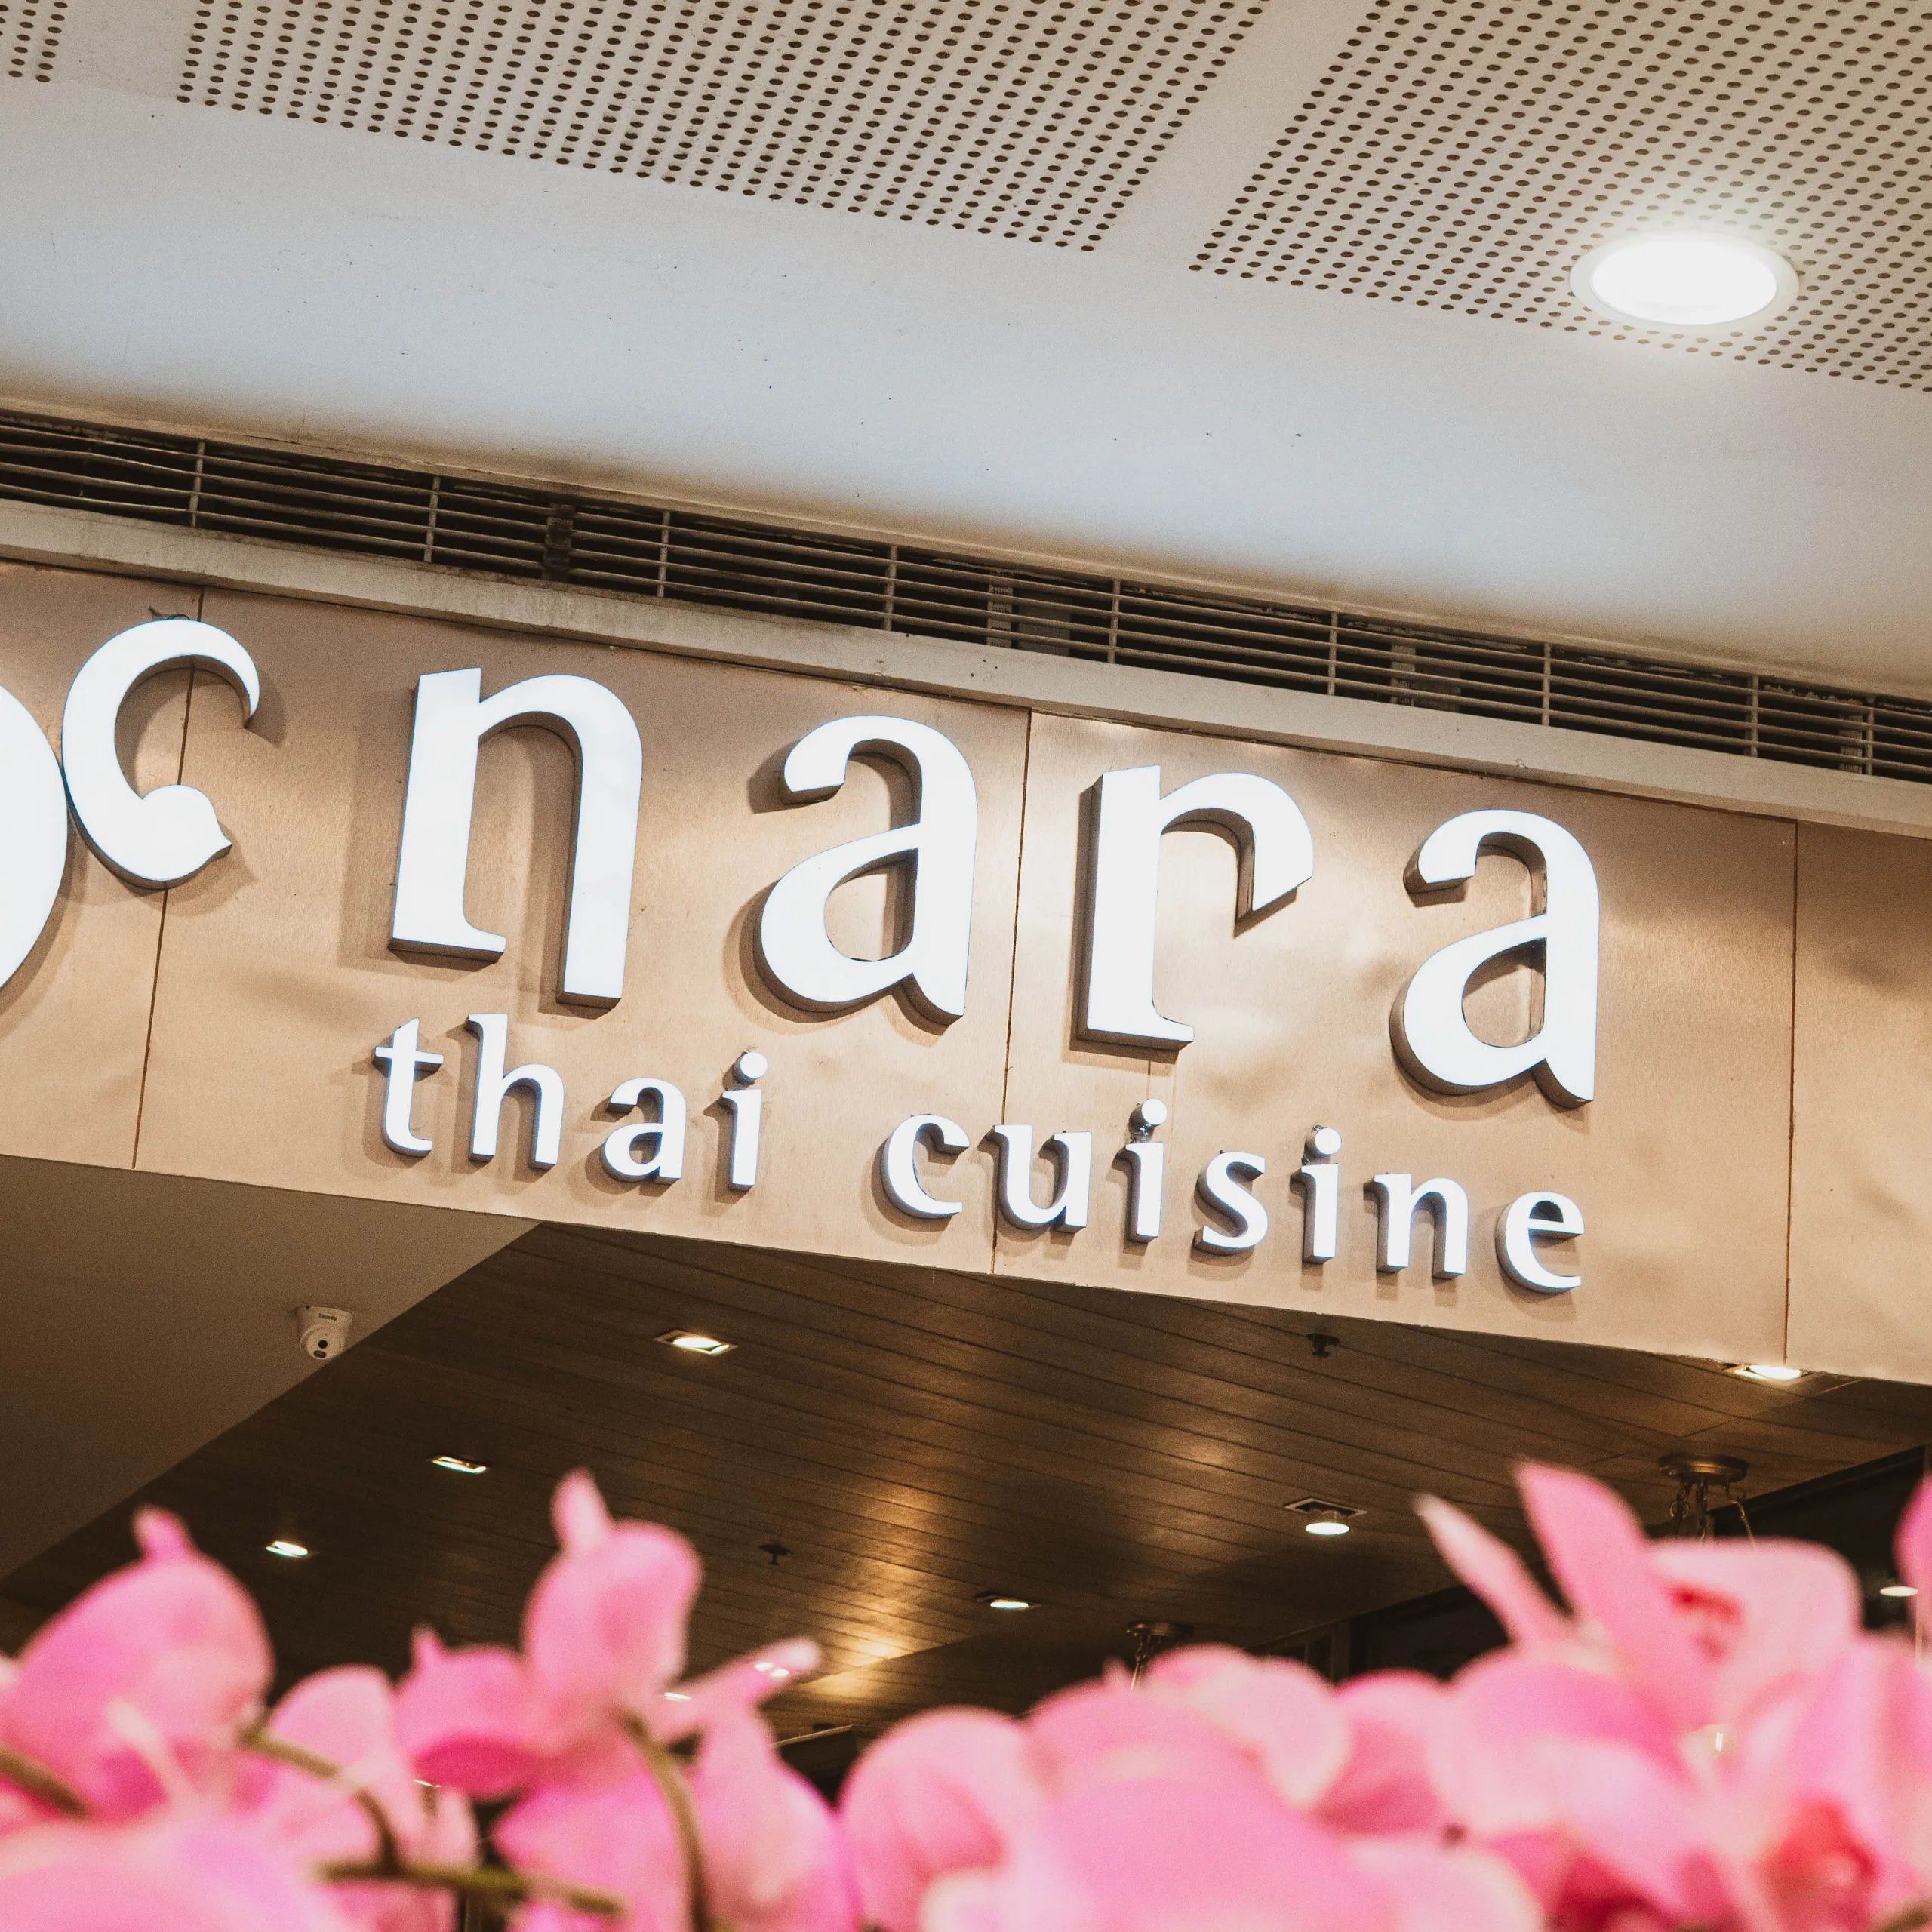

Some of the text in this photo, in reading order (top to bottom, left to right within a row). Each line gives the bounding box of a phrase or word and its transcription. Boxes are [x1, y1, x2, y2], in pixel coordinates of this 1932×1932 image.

[392, 667, 1601, 1102] nara
[374, 1013, 1585, 1291] thai cuisine
